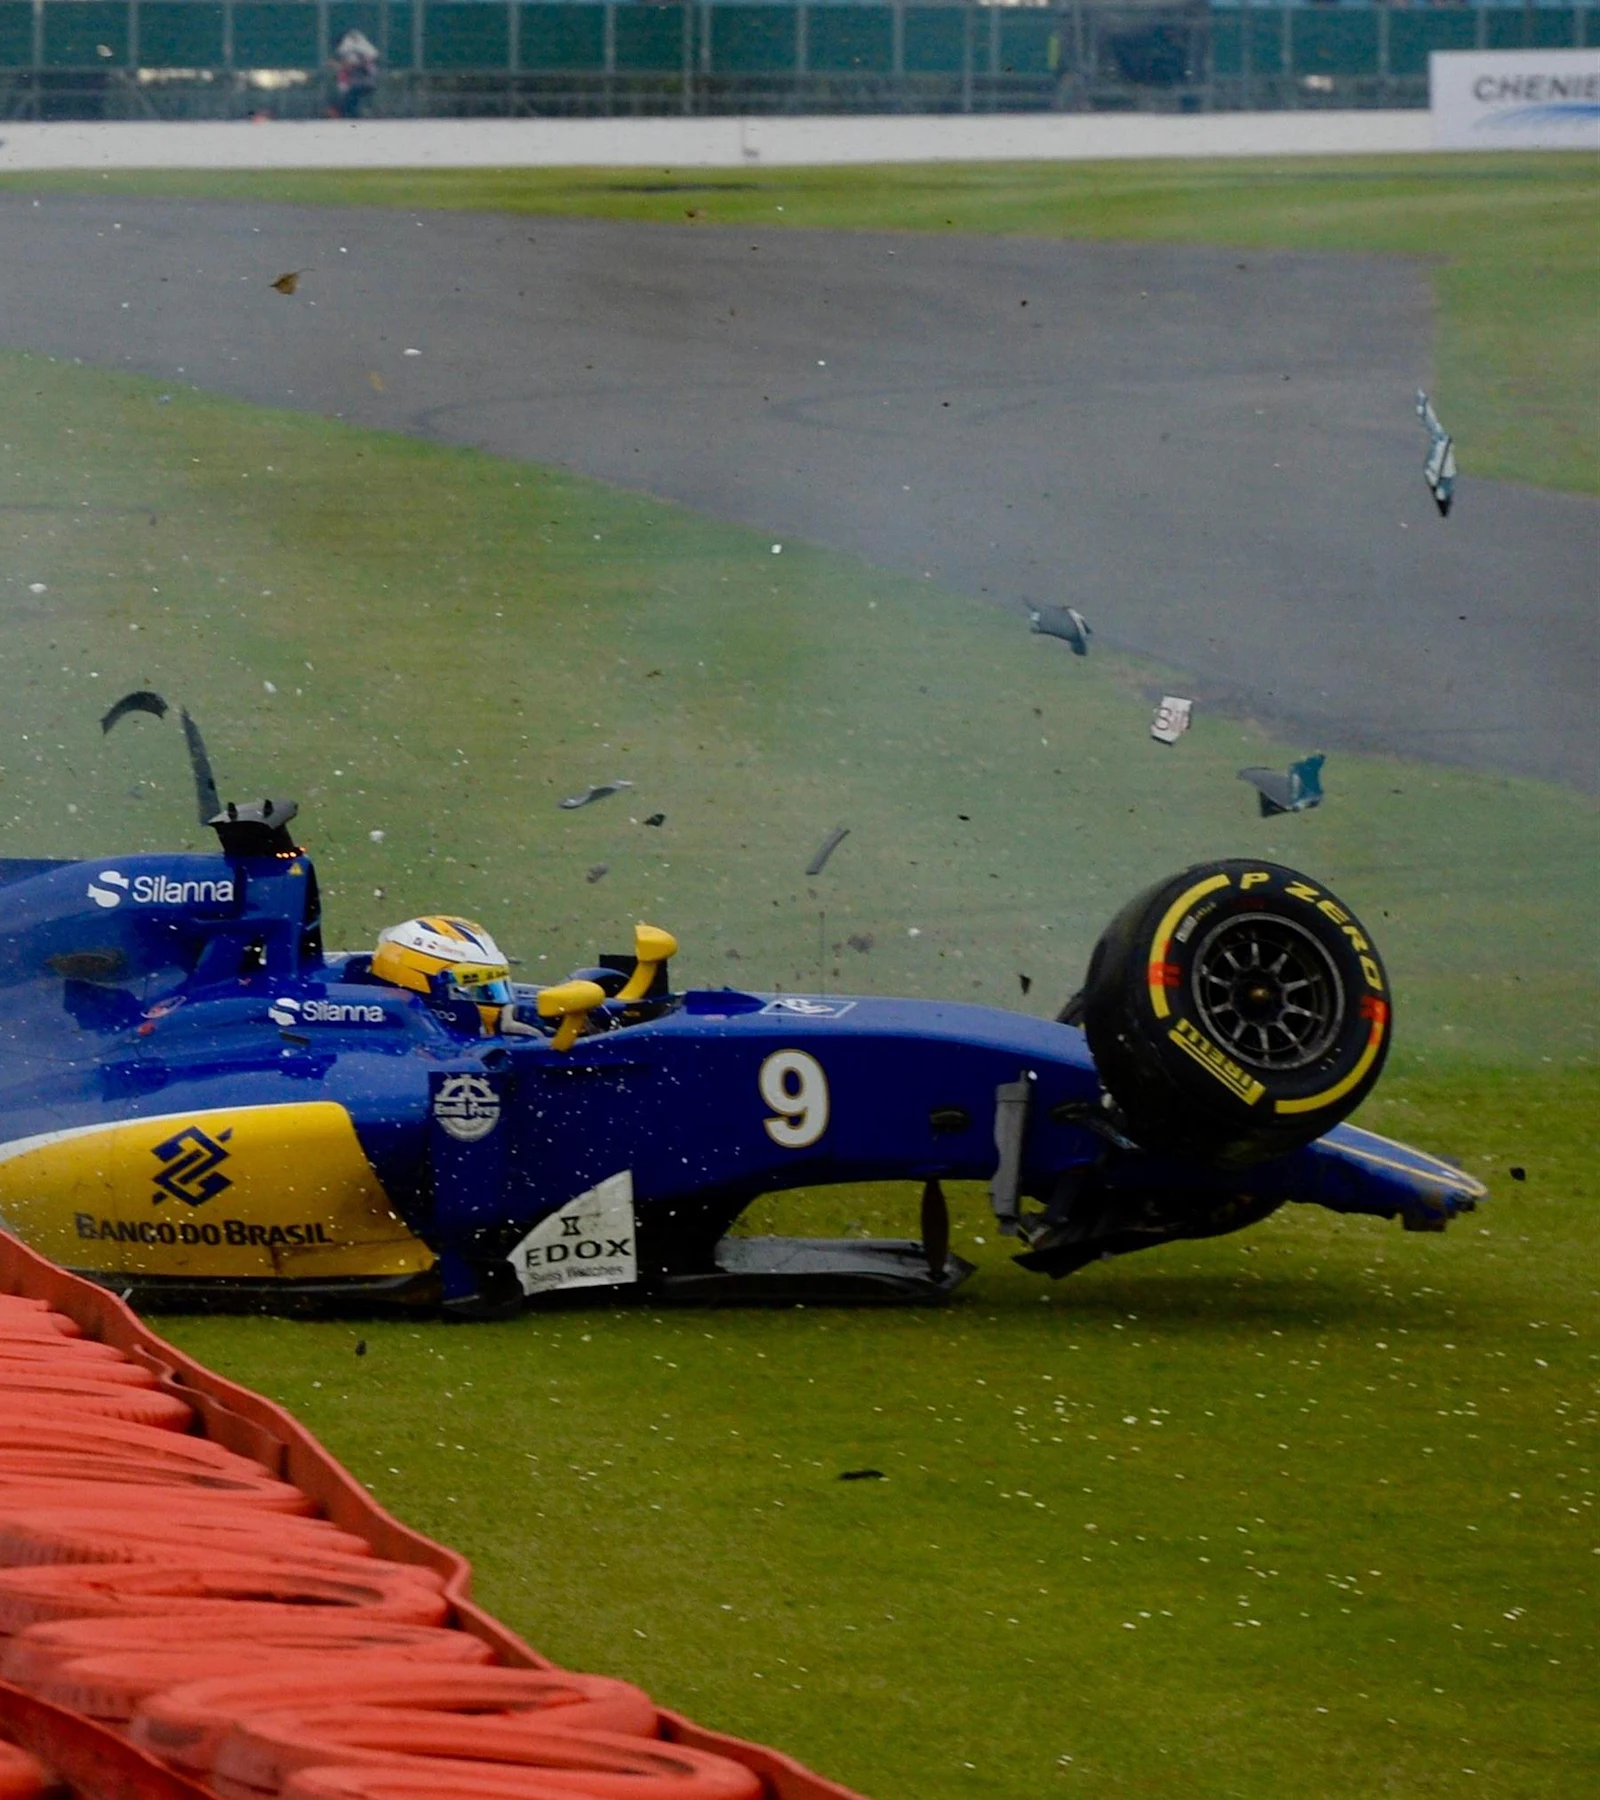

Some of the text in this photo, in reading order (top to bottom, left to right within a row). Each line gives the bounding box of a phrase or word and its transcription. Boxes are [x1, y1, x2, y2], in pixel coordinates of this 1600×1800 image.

[132, 875, 234, 903] Silanna
[1240, 872, 1270, 890] P
[1285, 880, 1384, 991] ZERO
[302, 1000, 385, 1023] Silanna
[1167, 1018, 1266, 1105] PIRELLI
[758, 1048, 830, 1148] 9
[74, 1212, 334, 1247] BANCO DO BRASIL
[526, 1239, 632, 1268] EDOX
